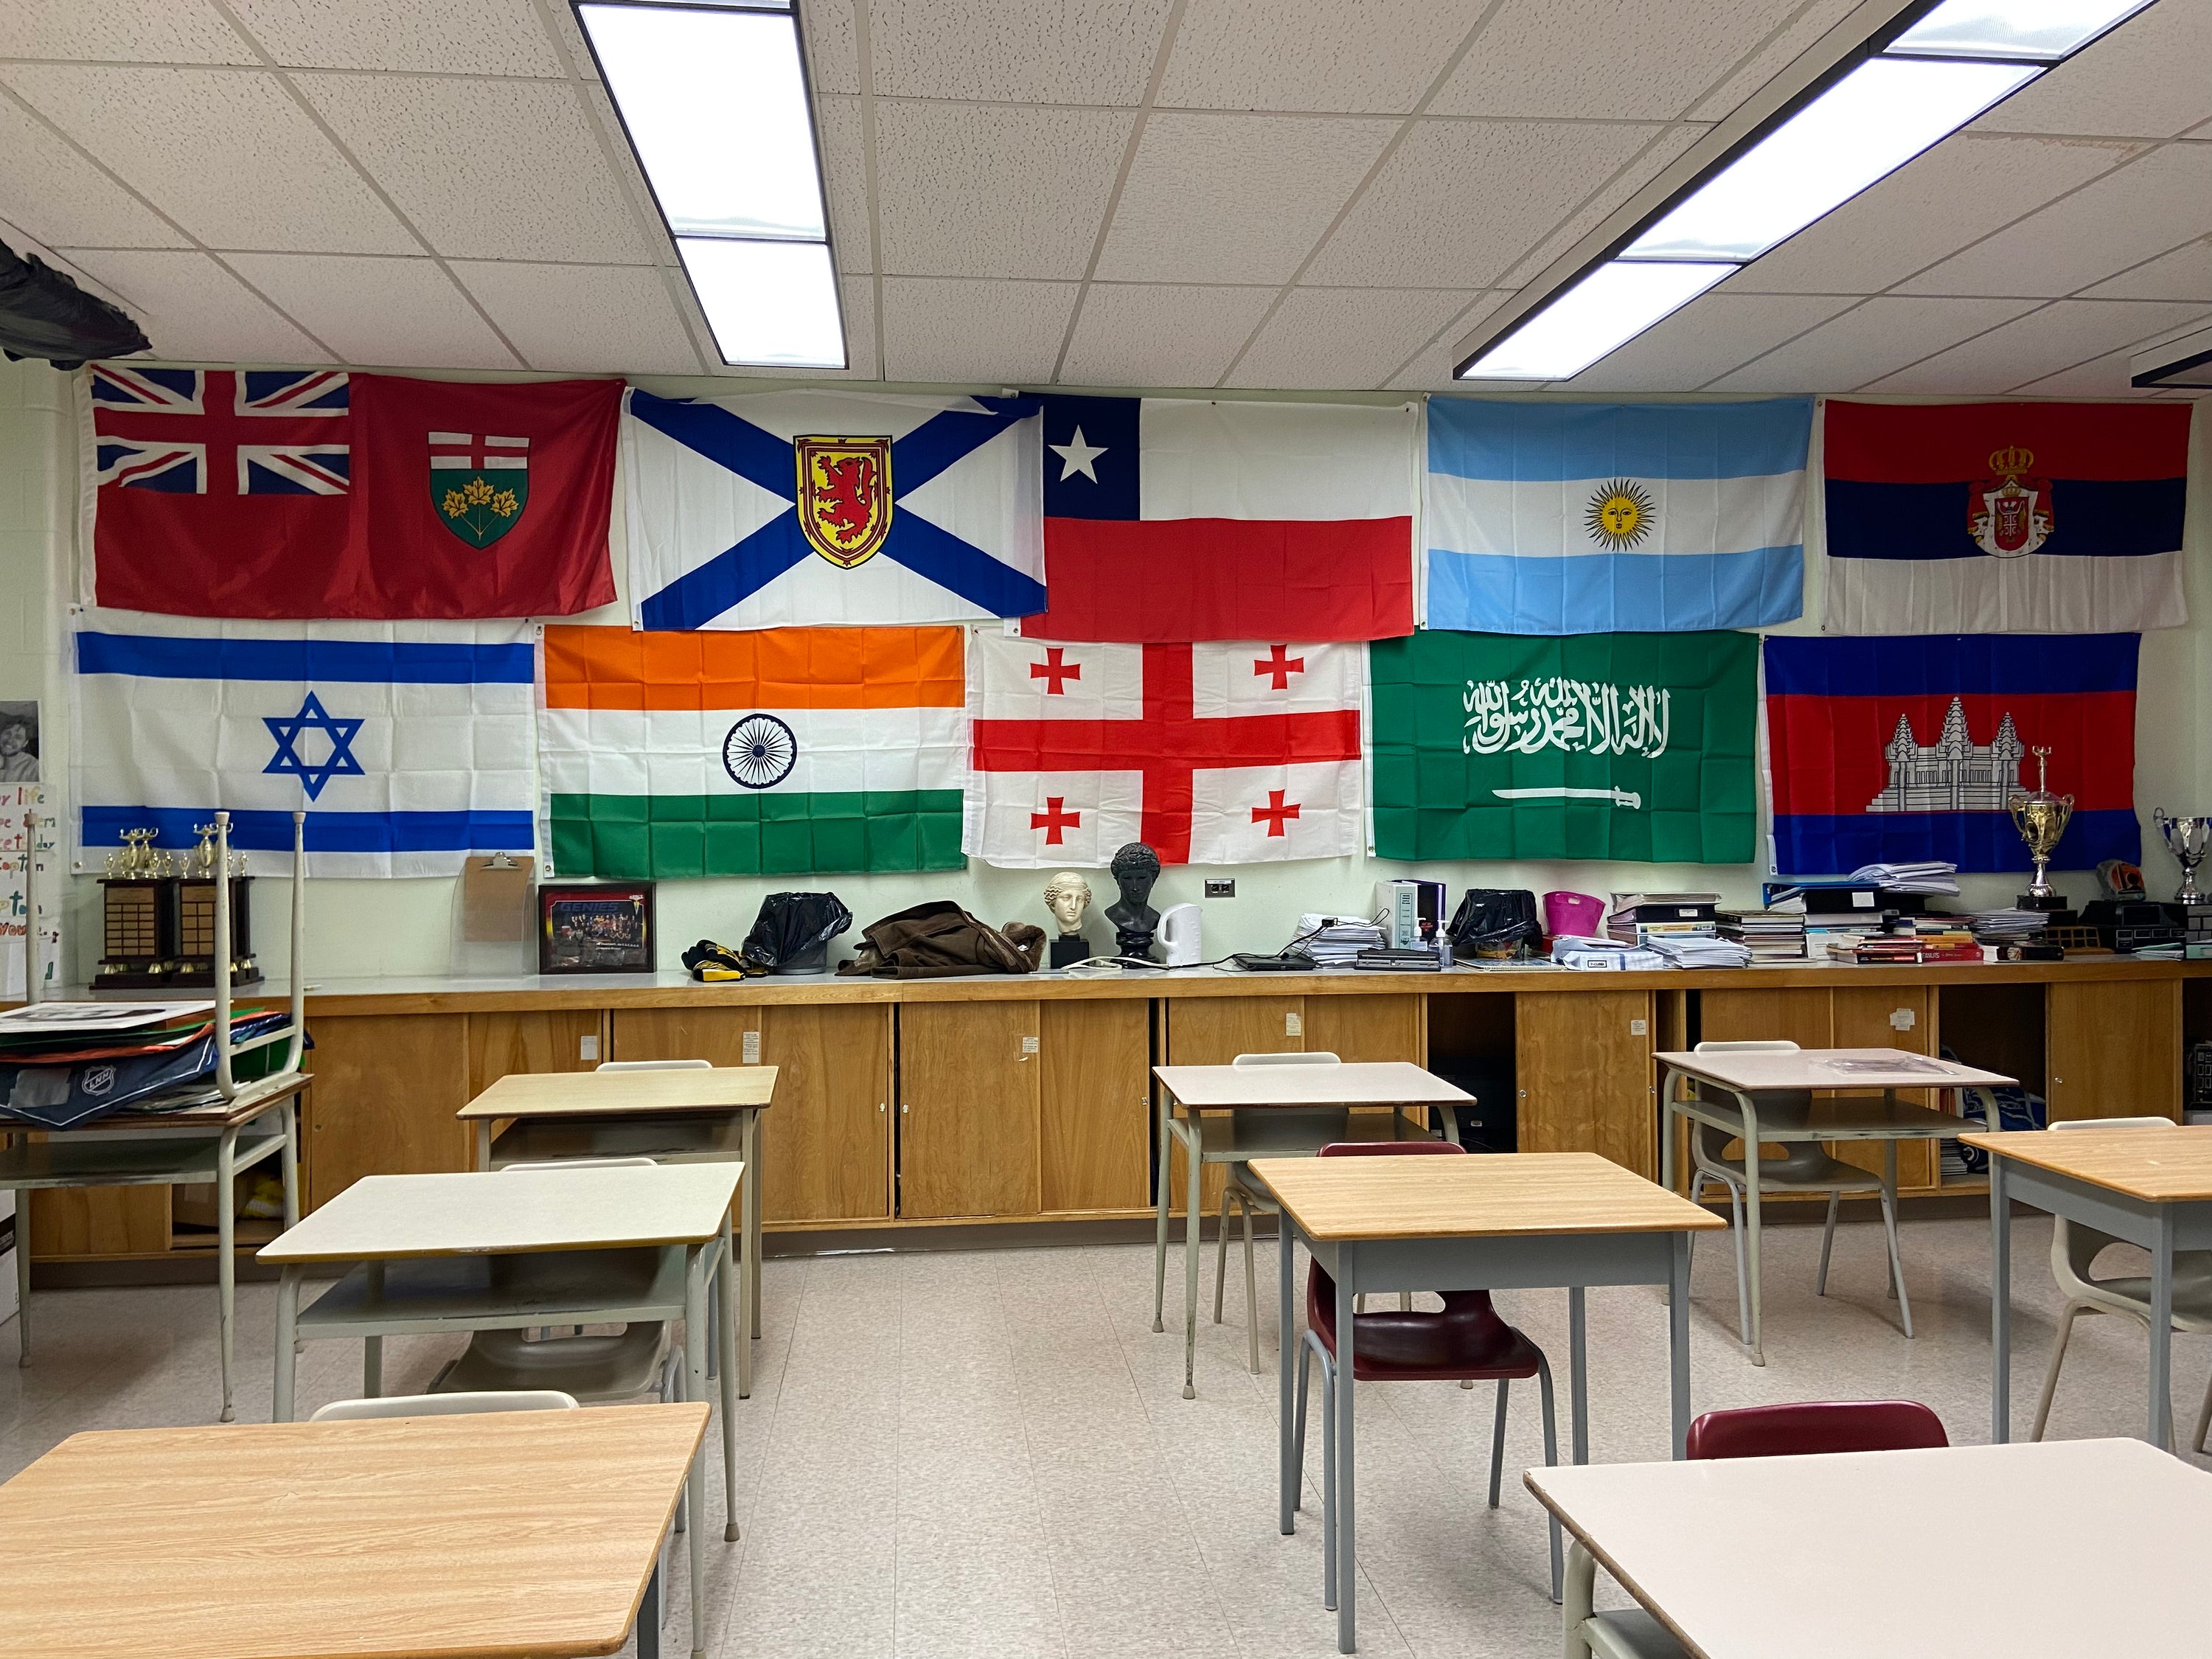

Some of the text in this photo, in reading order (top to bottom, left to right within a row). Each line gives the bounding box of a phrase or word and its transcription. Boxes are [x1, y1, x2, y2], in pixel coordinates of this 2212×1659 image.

[18, 786, 45, 805] life
[36, 833, 55, 849] day
[560, 902, 619, 912] GENIES
[88, 1071, 110, 1088] LNH
